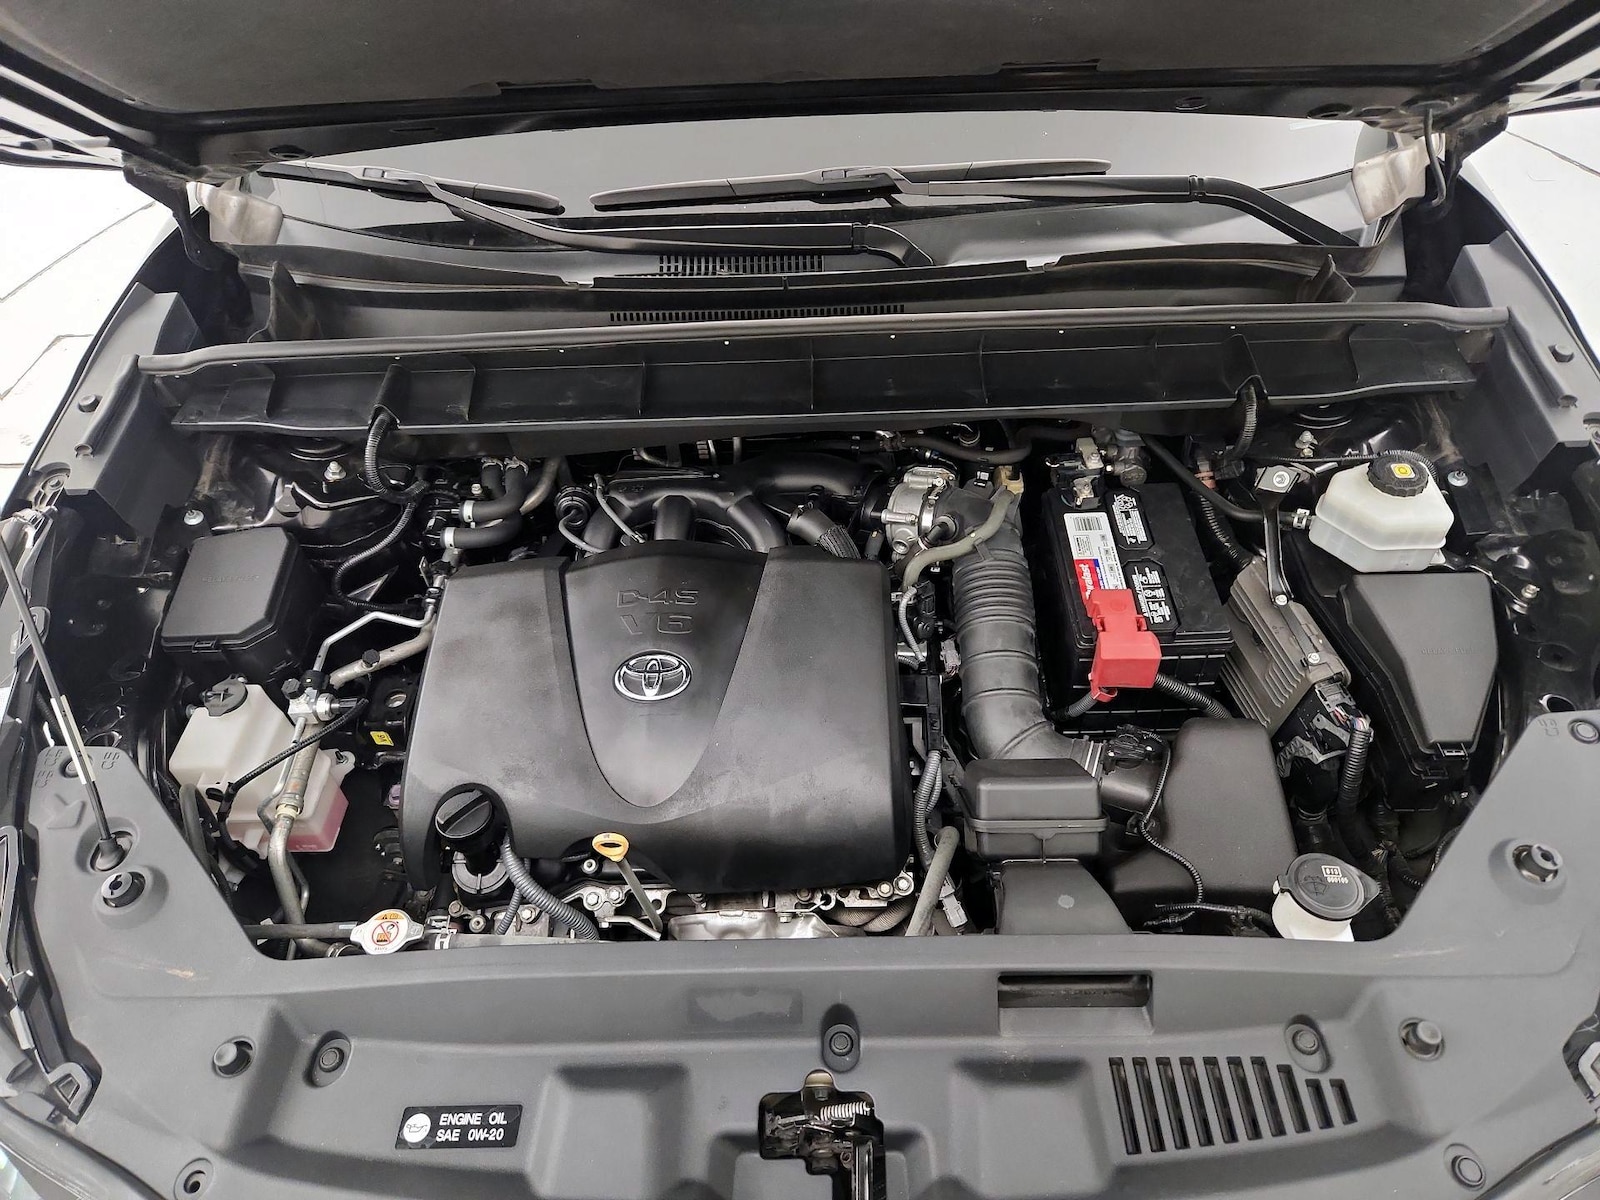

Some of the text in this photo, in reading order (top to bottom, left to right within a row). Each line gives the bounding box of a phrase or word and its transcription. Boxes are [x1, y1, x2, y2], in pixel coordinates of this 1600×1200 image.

[619, 612, 694, 636] V6
[439, 1112, 507, 1125] ENGINE OIL
[436, 1129, 461, 1142] SAE
